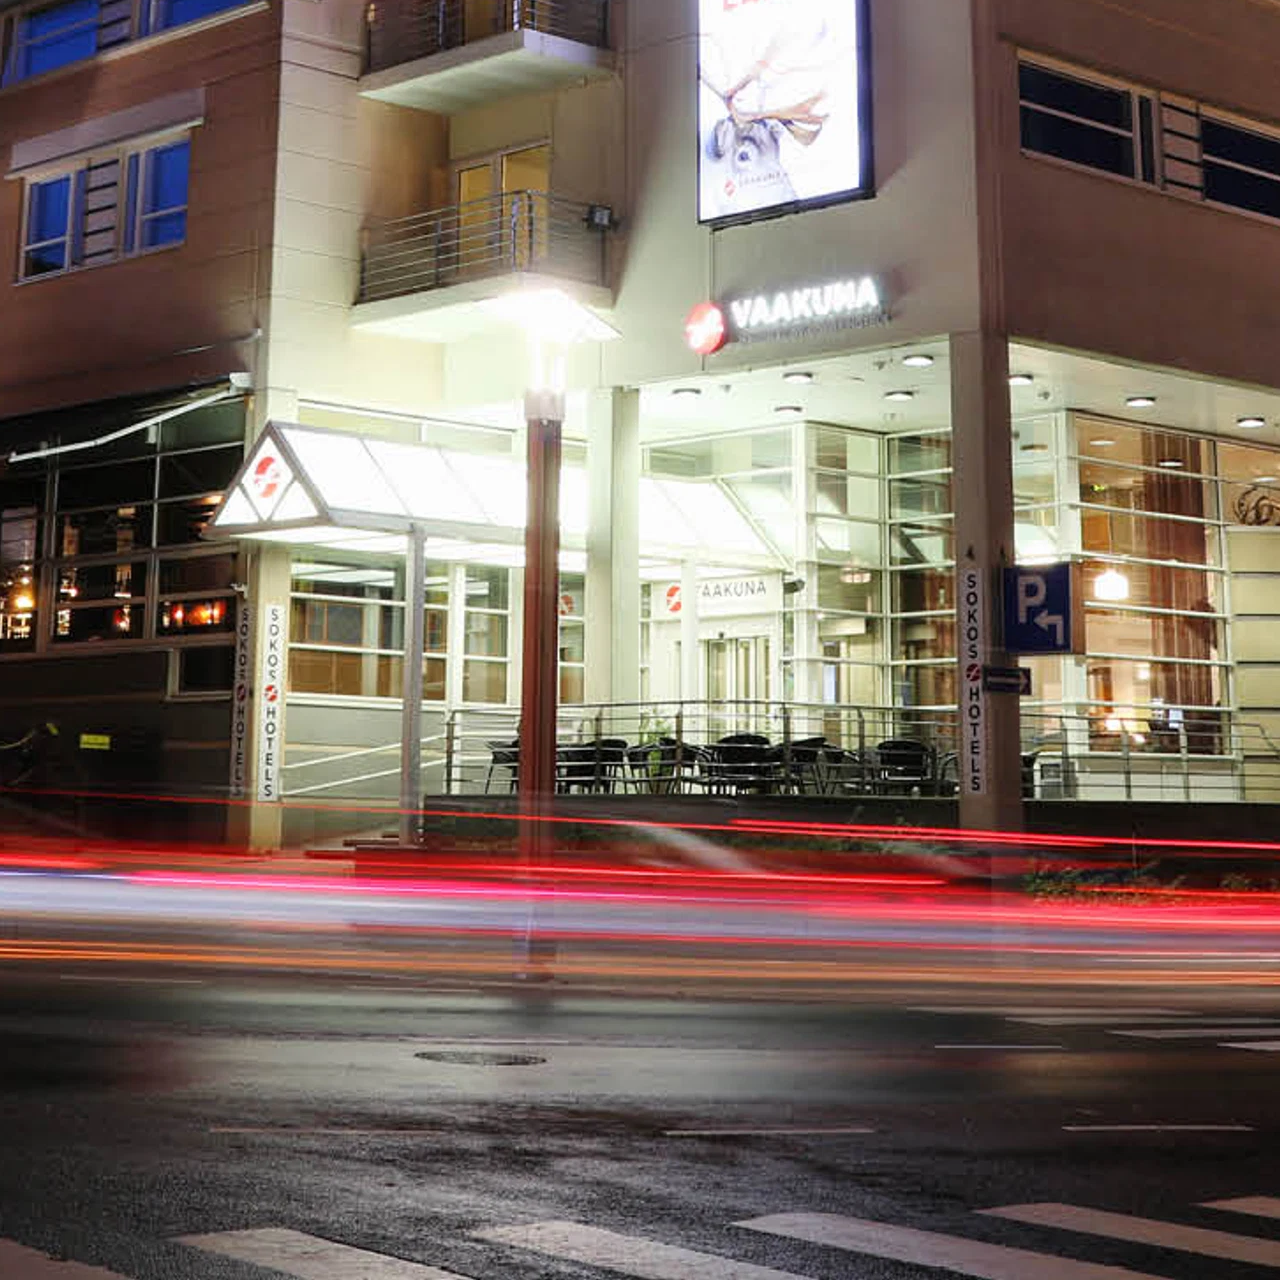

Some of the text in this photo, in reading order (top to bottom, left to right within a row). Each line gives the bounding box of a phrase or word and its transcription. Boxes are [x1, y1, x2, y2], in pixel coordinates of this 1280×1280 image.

[730, 276, 880, 329] VAAKUNA
[697, 581, 767, 597] AAKUNA
[965, 574, 978, 659] SOKOS
[1018, 575, 1046, 623] P
[267, 608, 280, 680] SOKOS
[232, 706, 246, 797] HOTELS
[264, 707, 277, 797] HOTELS
[969, 689, 981, 792] HOTELS
